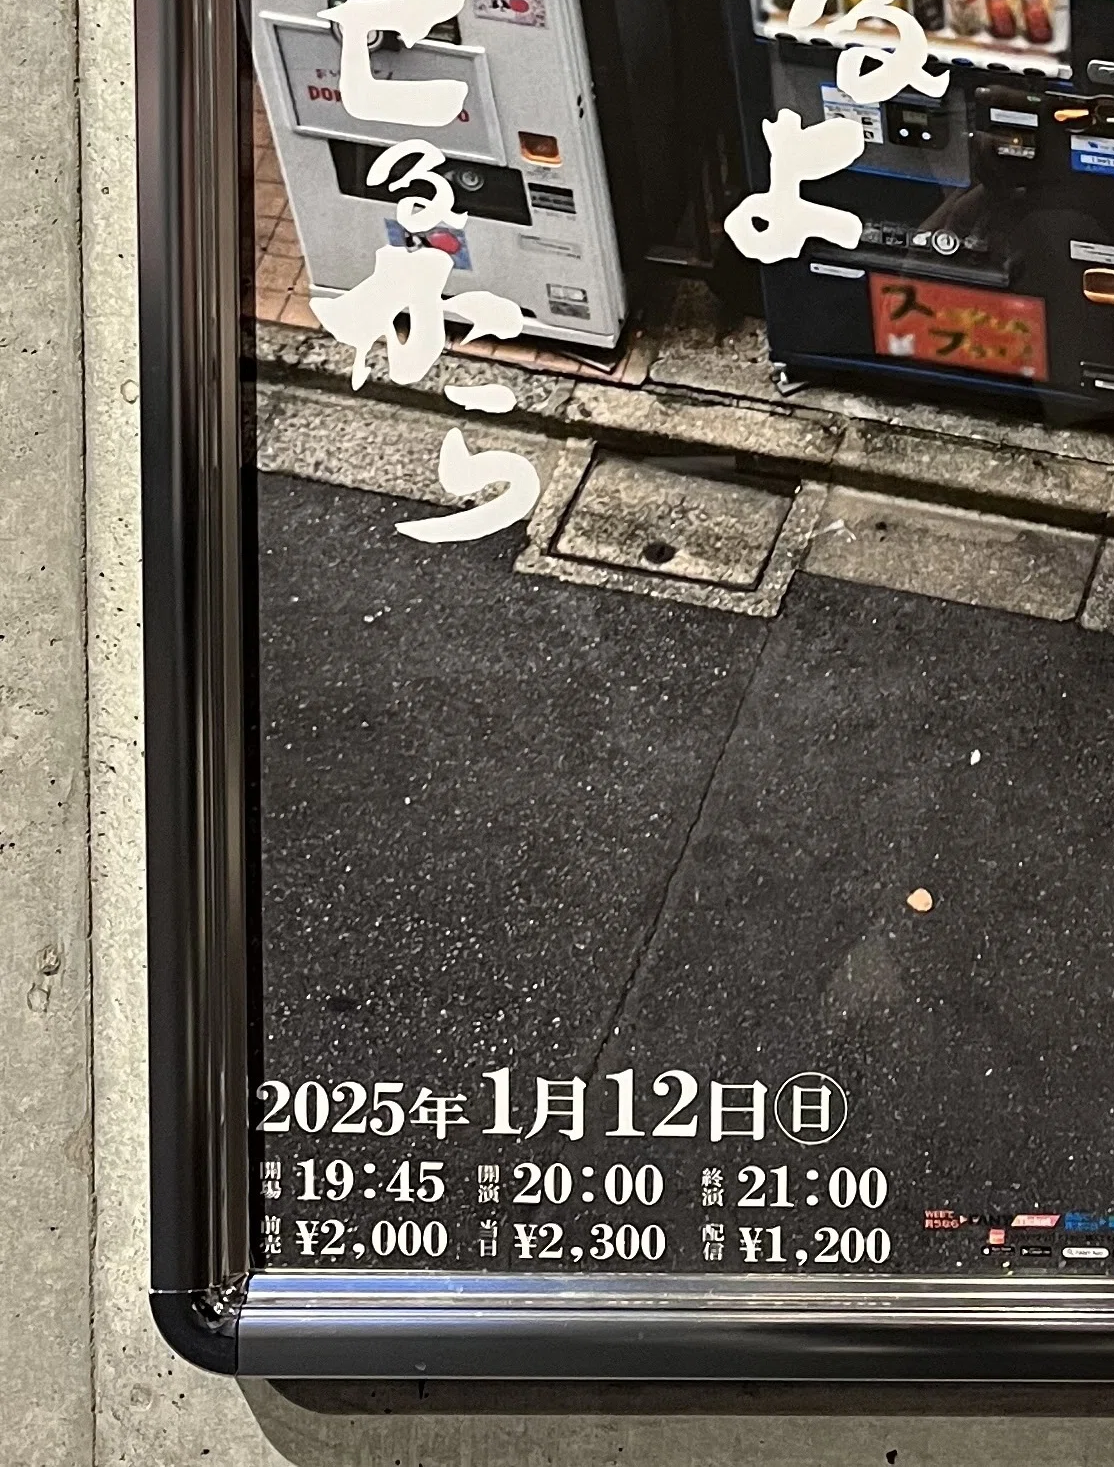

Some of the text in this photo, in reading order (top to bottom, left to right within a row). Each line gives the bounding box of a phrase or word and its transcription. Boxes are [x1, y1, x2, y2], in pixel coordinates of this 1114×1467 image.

[296, 1158, 446, 1204] 19:45
[512, 1162, 664, 1206] 20:00
[737, 1166, 888, 1209] 21:00
[295, 1218, 449, 1260] ¥2,000
[513, 1222, 667, 1263] ¥2,300
[739, 1227, 892, 1267] ¥1,200
